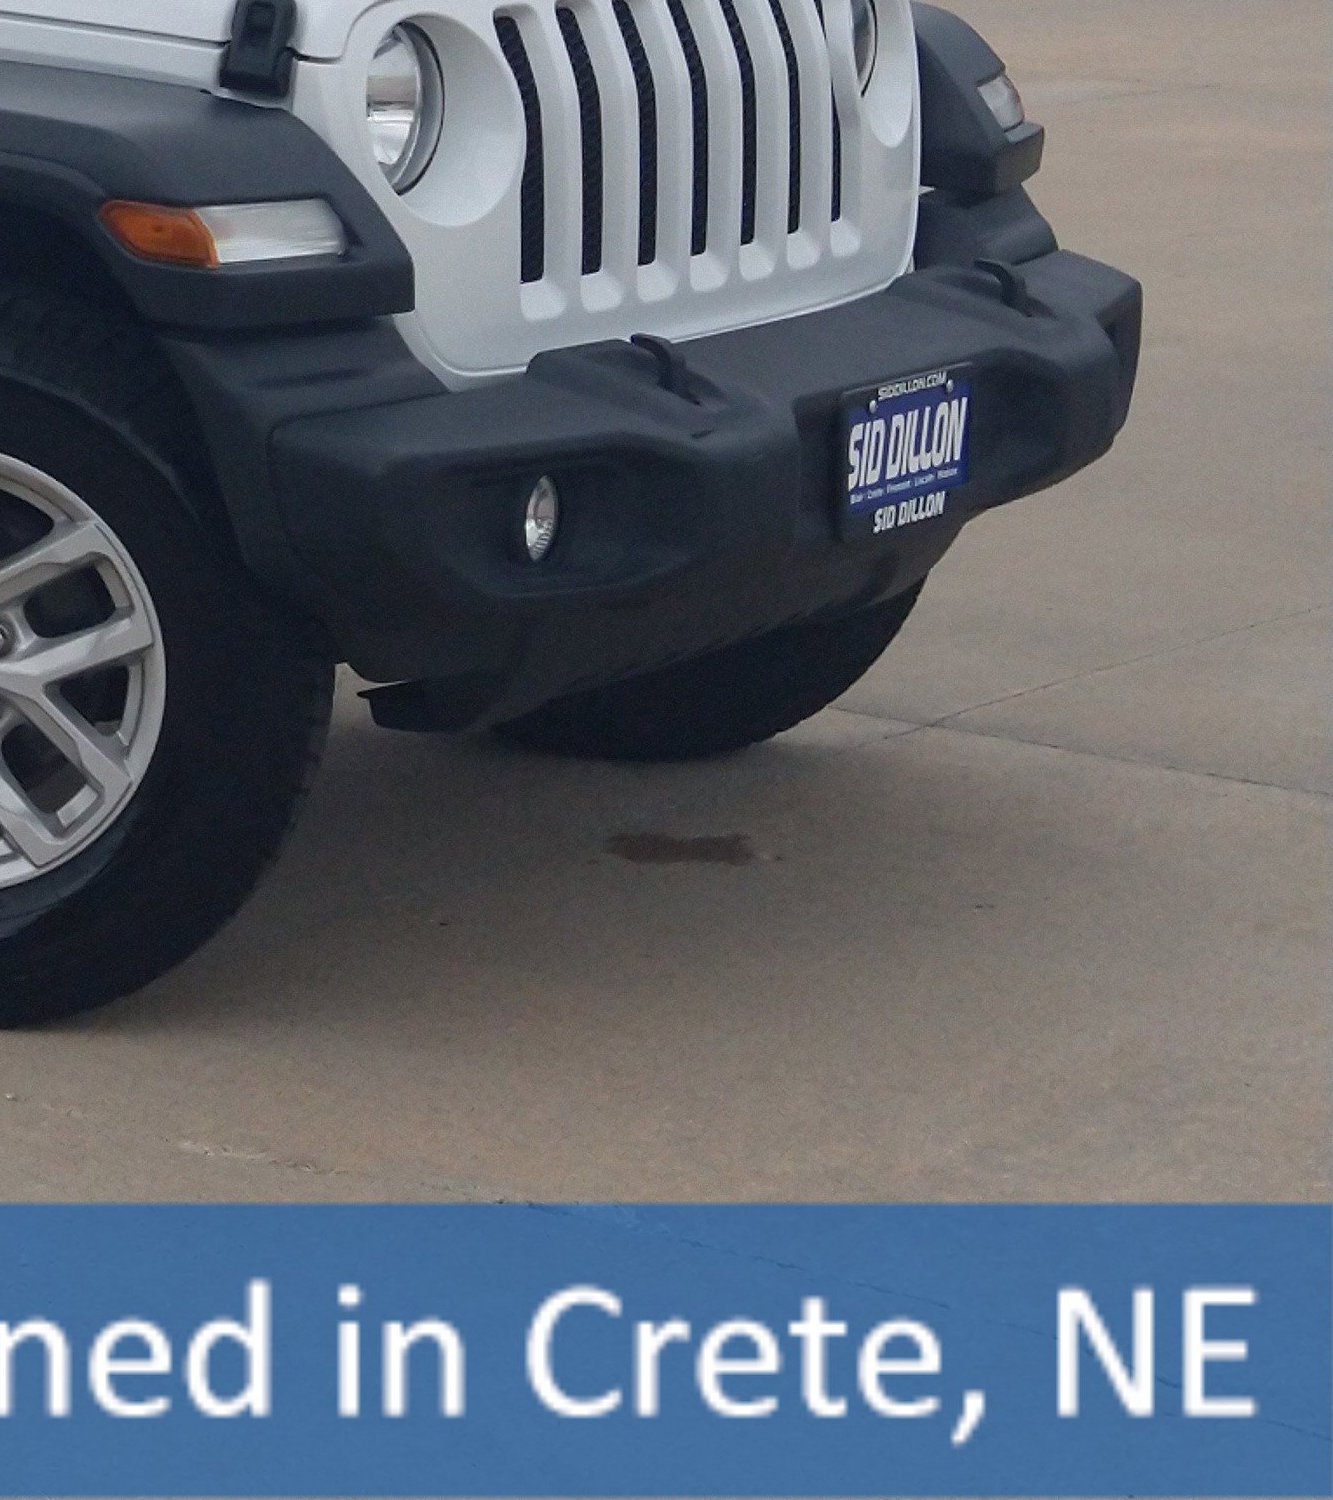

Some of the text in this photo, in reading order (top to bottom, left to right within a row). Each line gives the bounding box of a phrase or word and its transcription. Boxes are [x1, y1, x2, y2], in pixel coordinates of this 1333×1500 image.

[847, 417, 886, 492] SID
[886, 396, 968, 480] DILLON
[873, 491, 946, 534] SID DILLON
